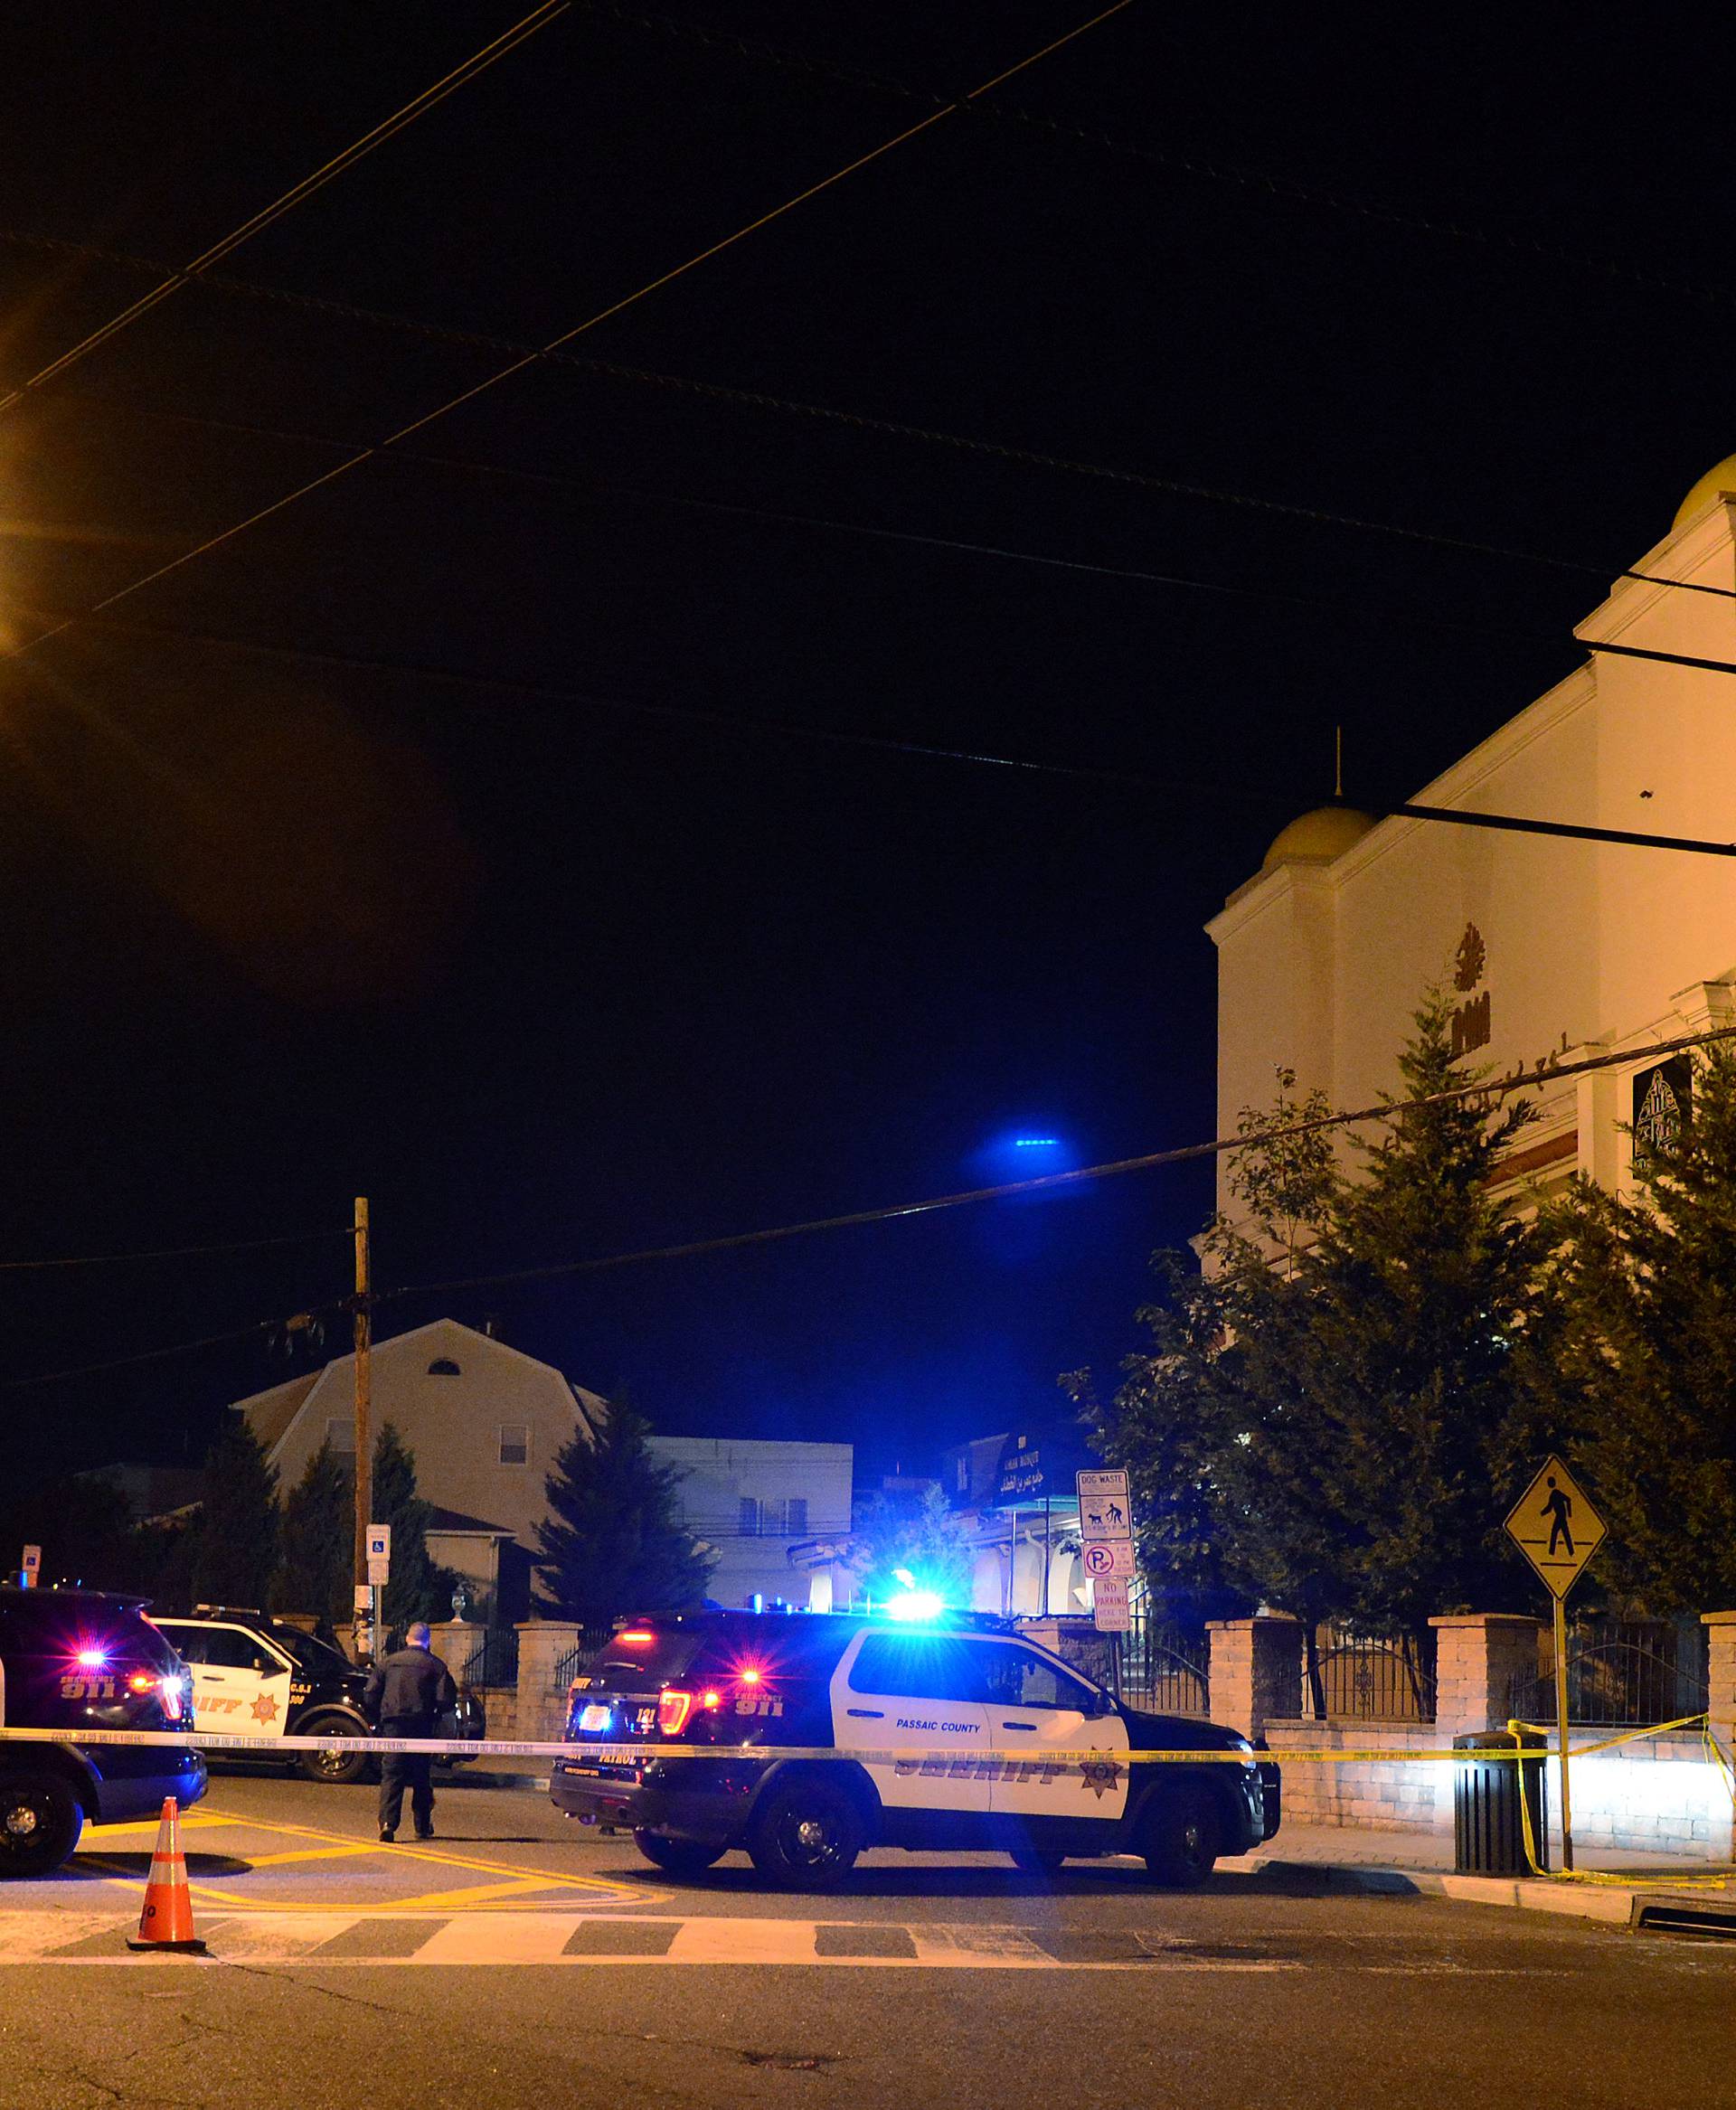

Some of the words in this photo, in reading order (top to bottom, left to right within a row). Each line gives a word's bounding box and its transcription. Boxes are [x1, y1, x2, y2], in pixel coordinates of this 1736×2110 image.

[1081, 1475, 1098, 1484] DOG
[1099, 1474, 1123, 1484] WASTE
[1104, 1584, 1117, 1593] NO
[1097, 1597, 1128, 1606] PARKING
[60, 1683, 115, 1700] 911
[735, 1700, 783, 1717] 911
[896, 1719, 937, 1730] PASSAIC
[941, 1722, 981, 1734] COUNTY
